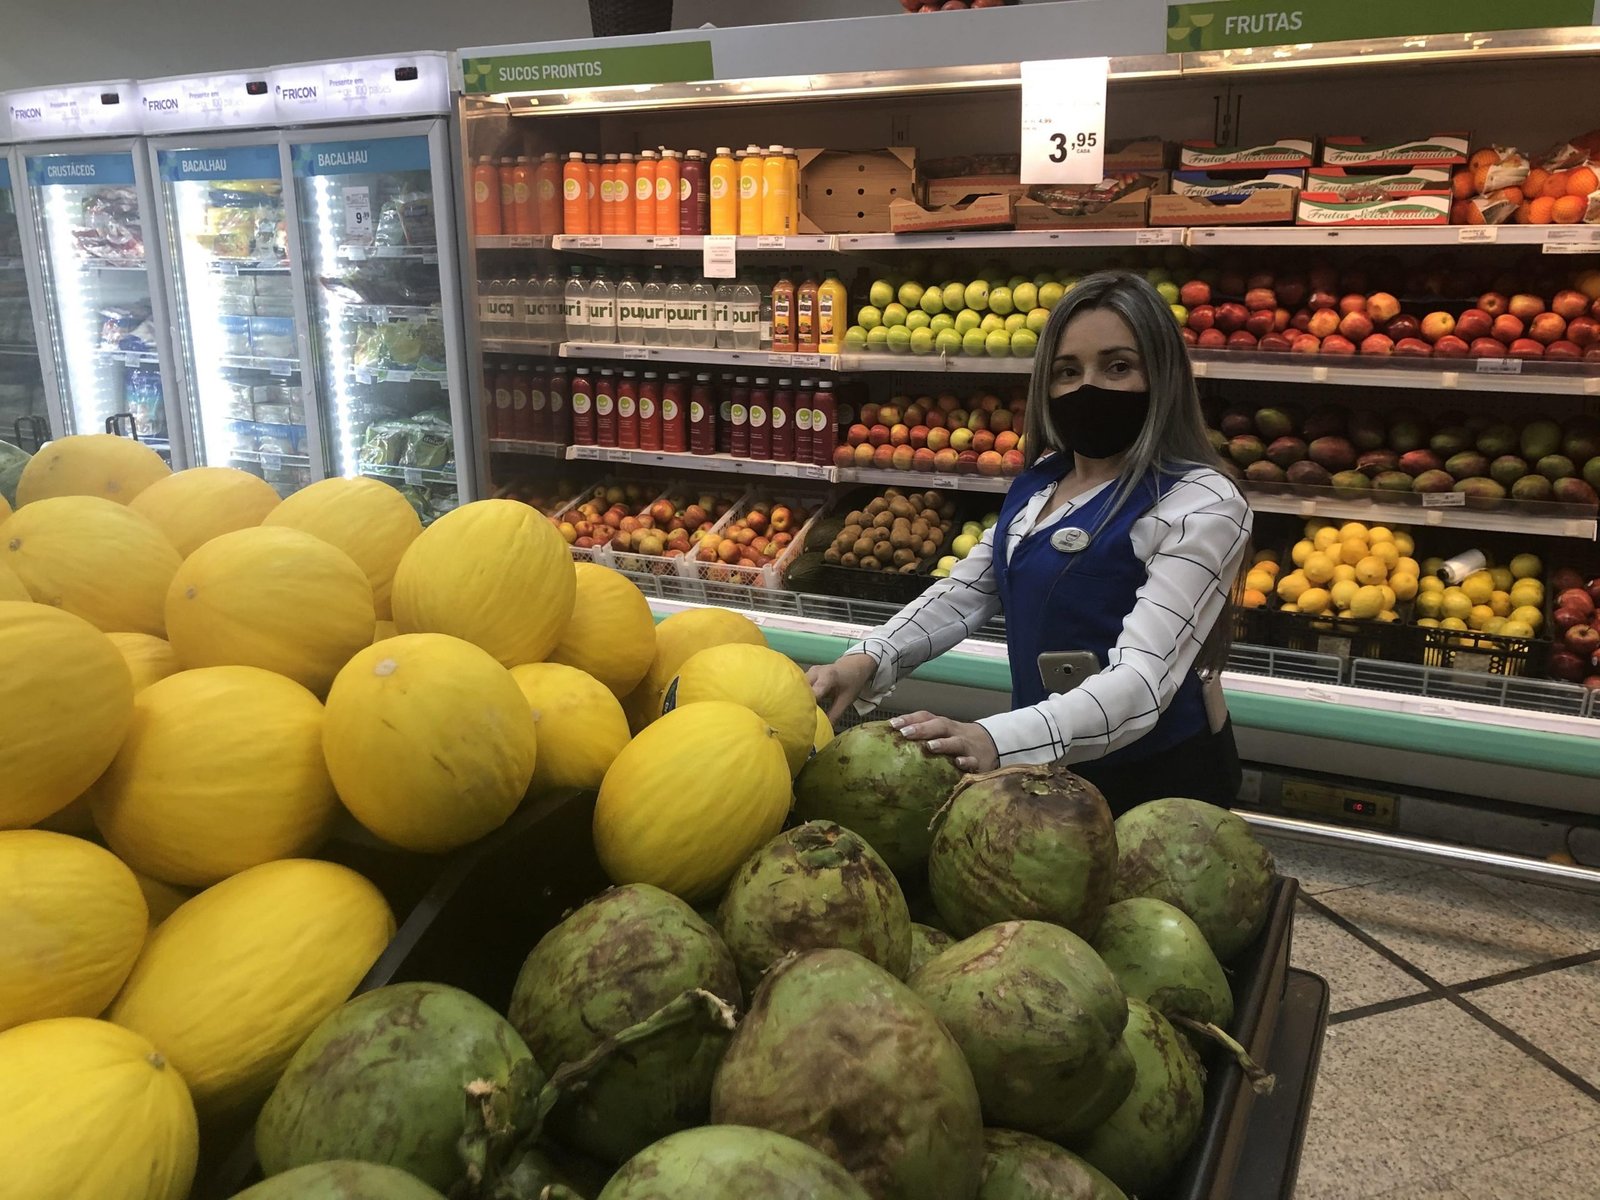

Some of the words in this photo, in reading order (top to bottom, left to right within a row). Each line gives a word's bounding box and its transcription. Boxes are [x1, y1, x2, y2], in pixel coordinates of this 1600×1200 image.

[1225, 11, 1303, 35] FRUTAS
[499, 66, 540, 81] SUCOS
[542, 61, 602, 79] PRONTOS
[282, 86, 317, 100] FRICON
[148, 98, 179, 111] FRICON
[15, 108, 42, 120] FRICON
[317, 150, 368, 167] BACALHAU
[1189, 153, 1227, 164] Frutas
[1329, 150, 1372, 162] Frutas
[47, 162, 96, 178] CRUSTÁCEOS
[182, 159, 227, 173] BACALHAU
[1307, 208, 1351, 221] Frutas
